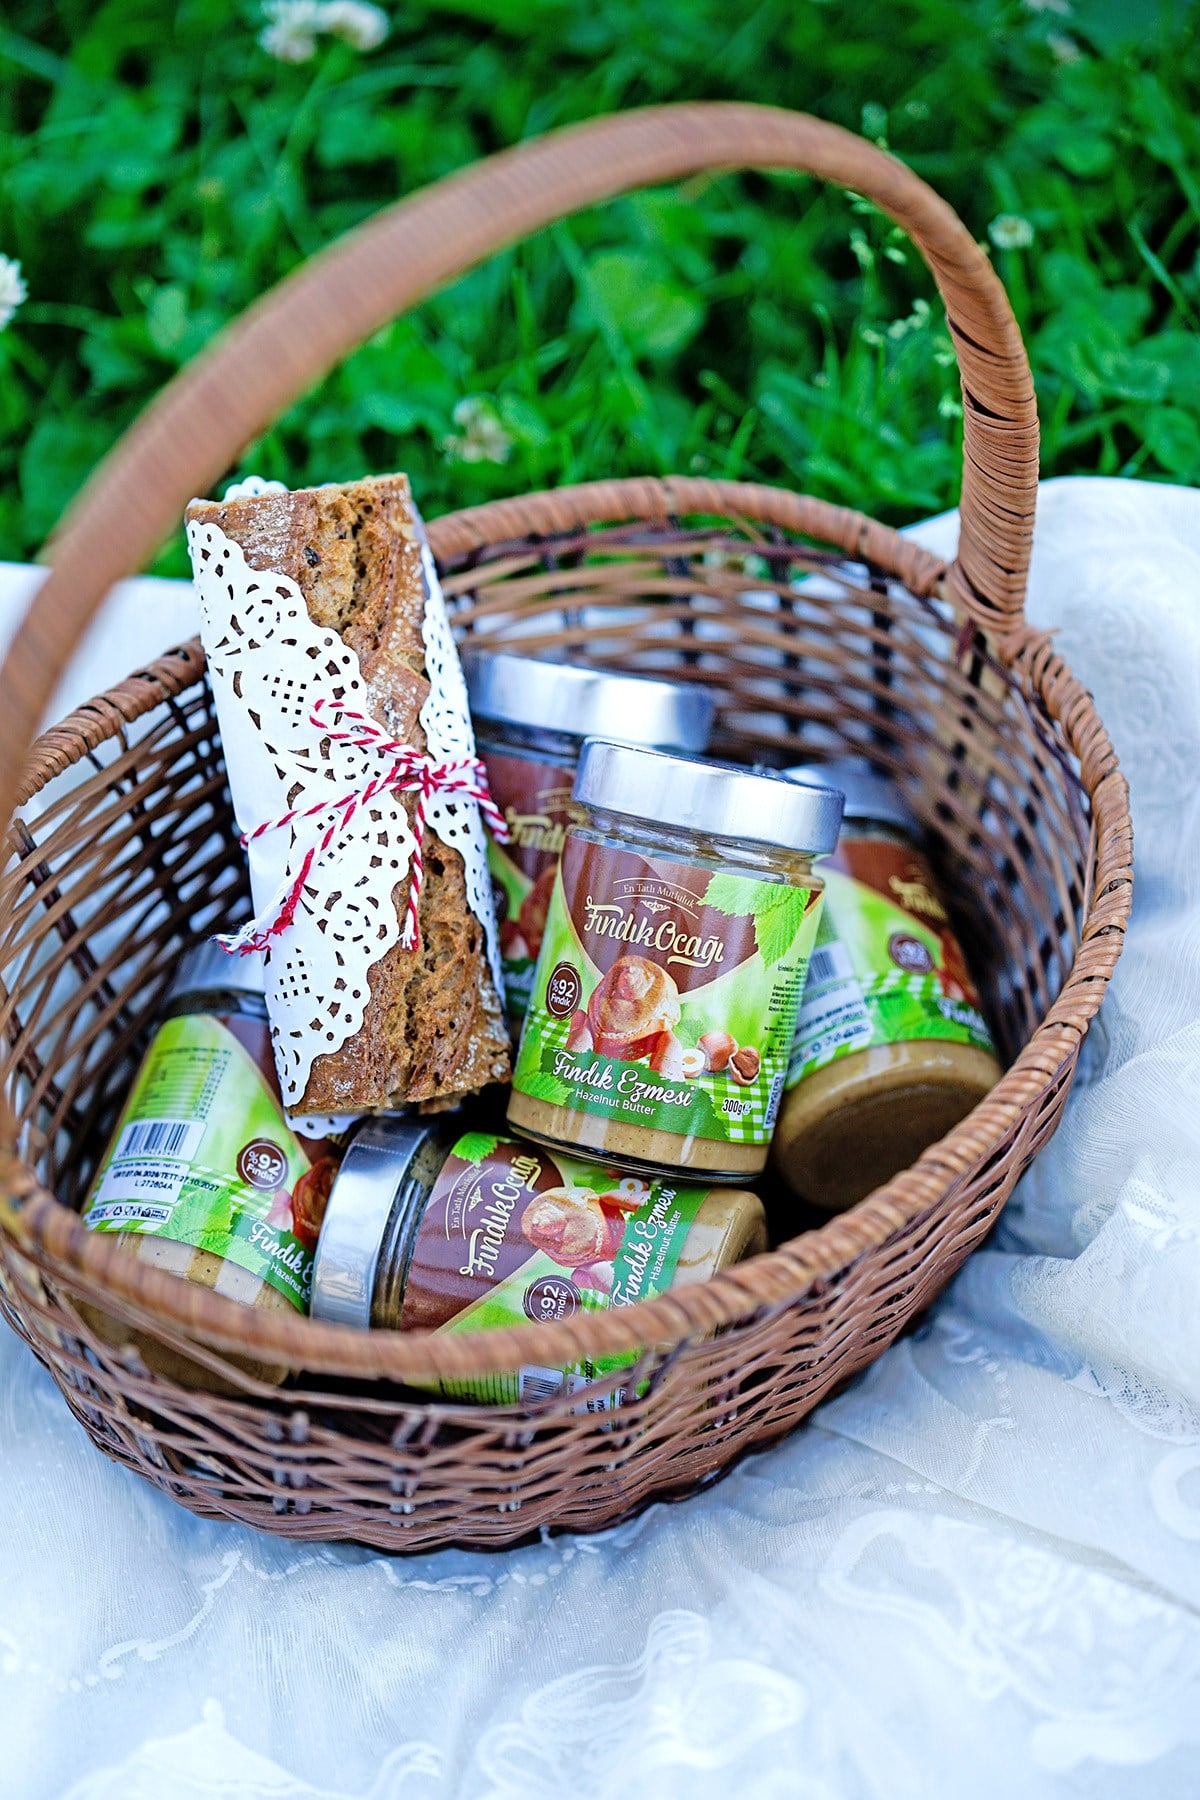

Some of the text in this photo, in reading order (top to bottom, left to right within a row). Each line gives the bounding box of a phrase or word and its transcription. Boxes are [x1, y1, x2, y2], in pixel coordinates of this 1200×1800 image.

[623, 883, 695, 909] En Tatlı Mutluluk
[552, 979, 575, 998] %92
[552, 1049, 696, 1107] Fındık Ezmesi
[575, 1088, 657, 1116] Hazelnut Butter
[249, 1150, 282, 1176] %92
[634, 1186, 677, 1239] Ezmesi
[249, 1221, 305, 1275] Fındık
[649, 1210, 682, 1281] Hazelnut Butter
[270, 1261, 302, 1295] Hazelnut
[540, 1285, 560, 1320] %92
